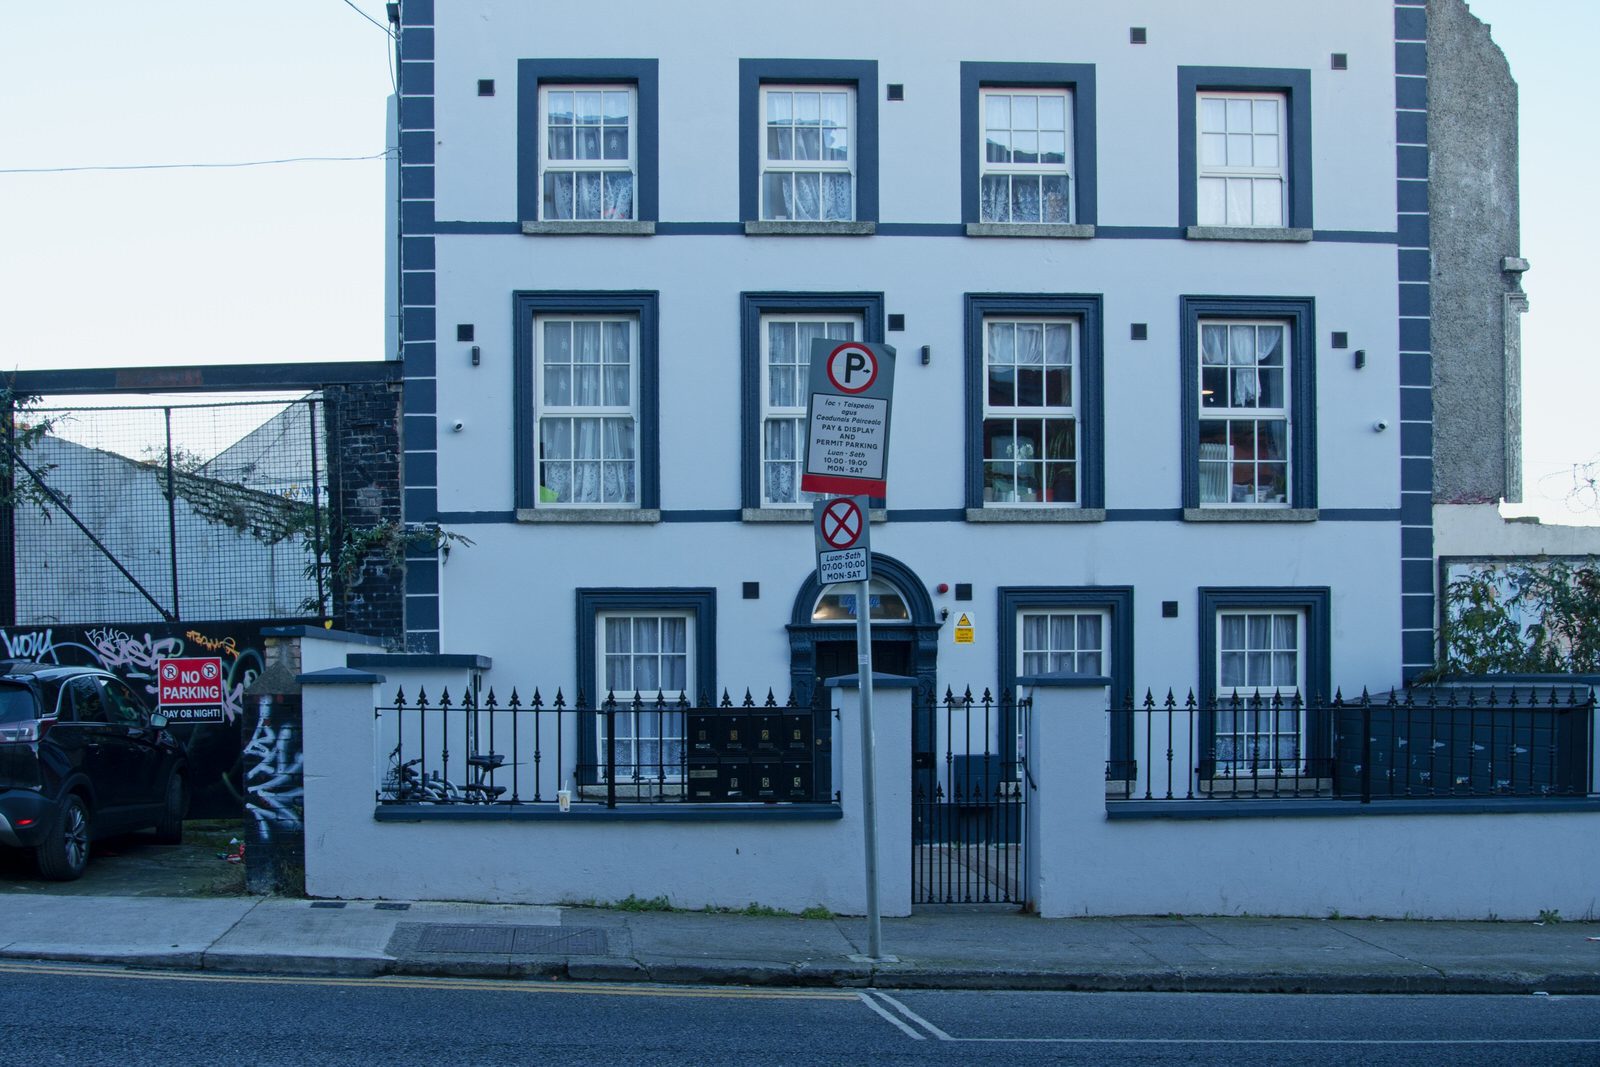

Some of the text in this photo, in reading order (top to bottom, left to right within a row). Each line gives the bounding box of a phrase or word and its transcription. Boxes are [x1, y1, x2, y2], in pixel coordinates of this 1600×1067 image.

[845, 352, 866, 383] P
[821, 424, 836, 432] PAY
[844, 426, 875, 435] DISPLAY
[839, 433, 856, 441] AND
[816, 439, 878, 450] PERMIT PARKING
[181, 670, 200, 684] NO
[163, 685, 219, 700] PARKING
[163, 708, 221, 718] DAY OR NIGHT!
